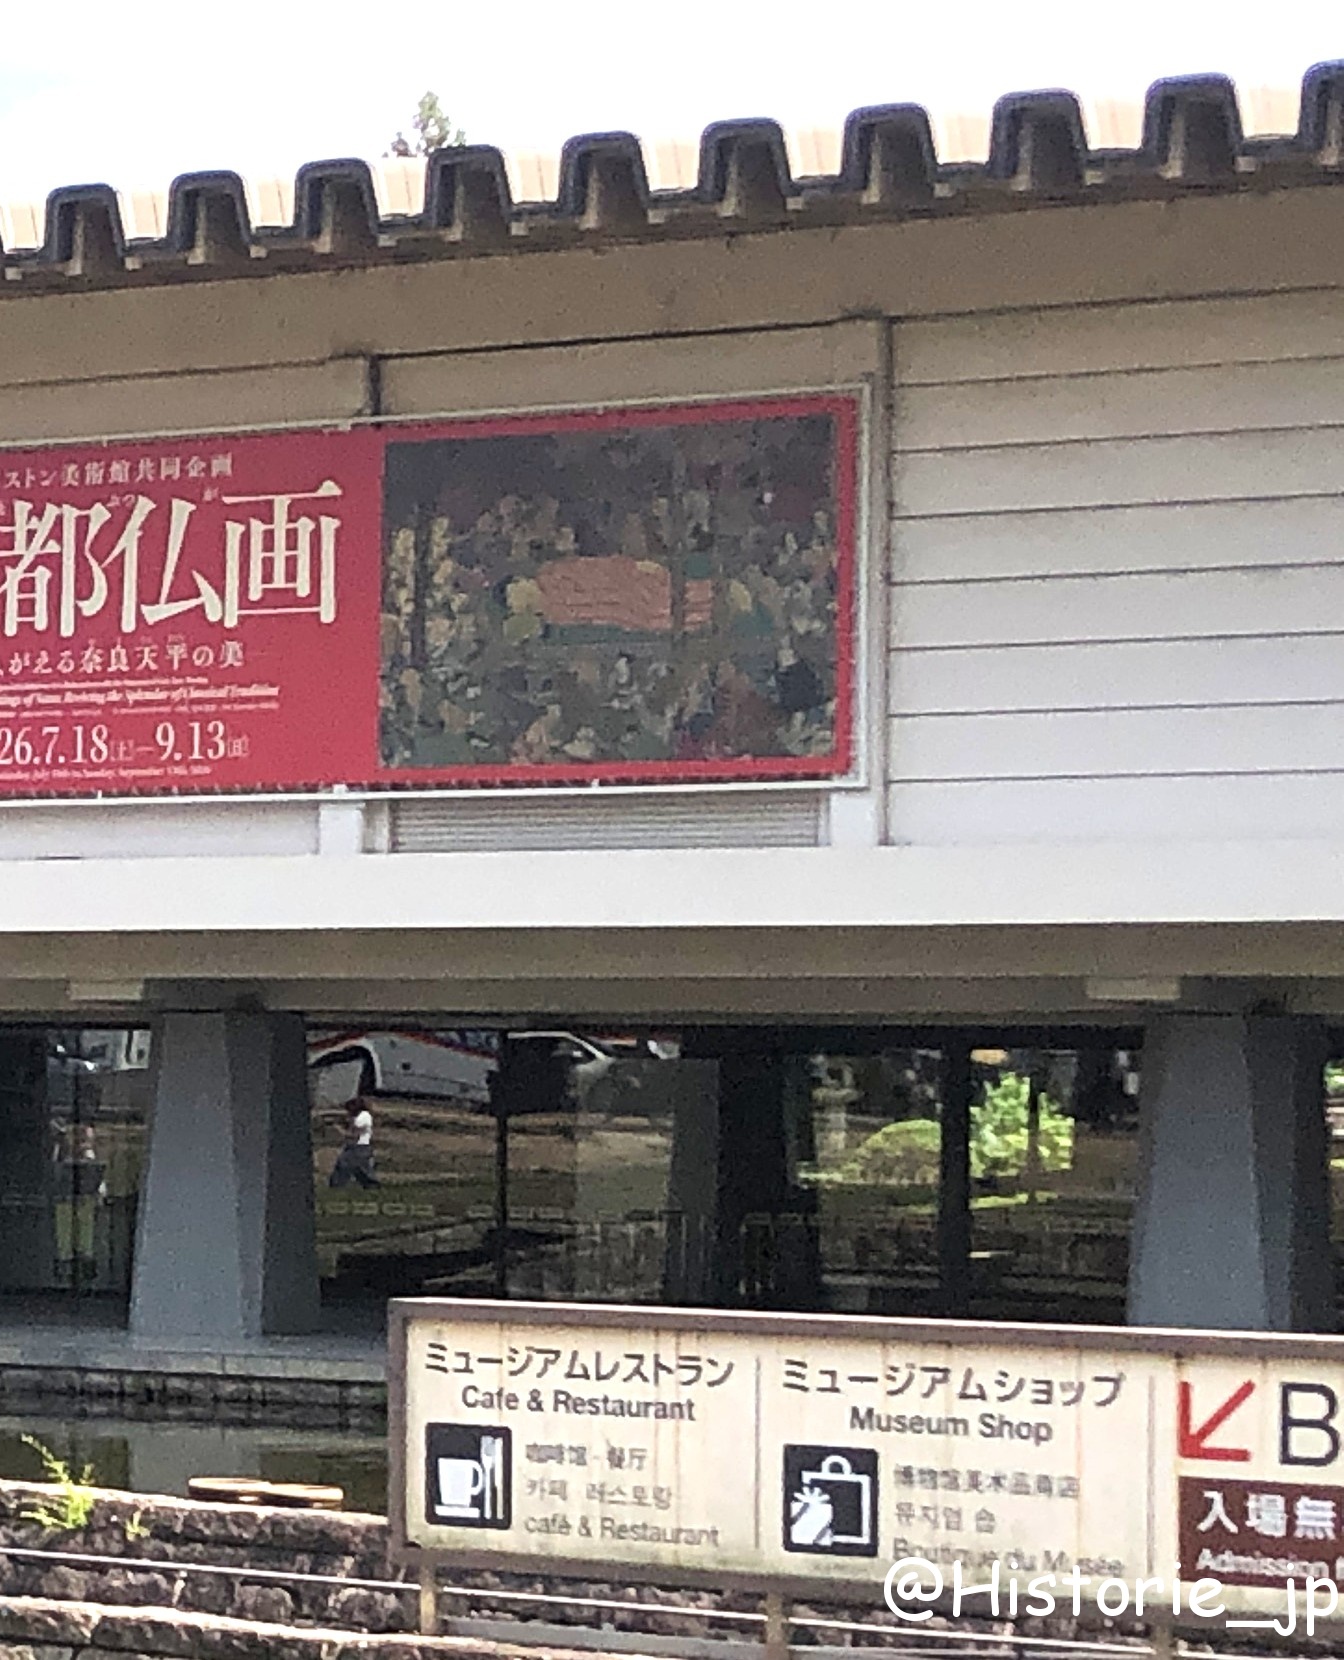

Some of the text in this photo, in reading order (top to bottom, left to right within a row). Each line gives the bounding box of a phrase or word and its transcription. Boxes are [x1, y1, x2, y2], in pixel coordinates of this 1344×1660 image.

[425, 1342, 735, 1388] ミュージアムレストラン
[782, 1358, 1127, 1408] ミュージアムショップ
[462, 1384, 697, 1422] Cafe & Restaurant
[849, 1405, 1054, 1446] Museum Shop
[578, 1515, 593, 1539] &
[600, 1516, 720, 1548] Restaurant
